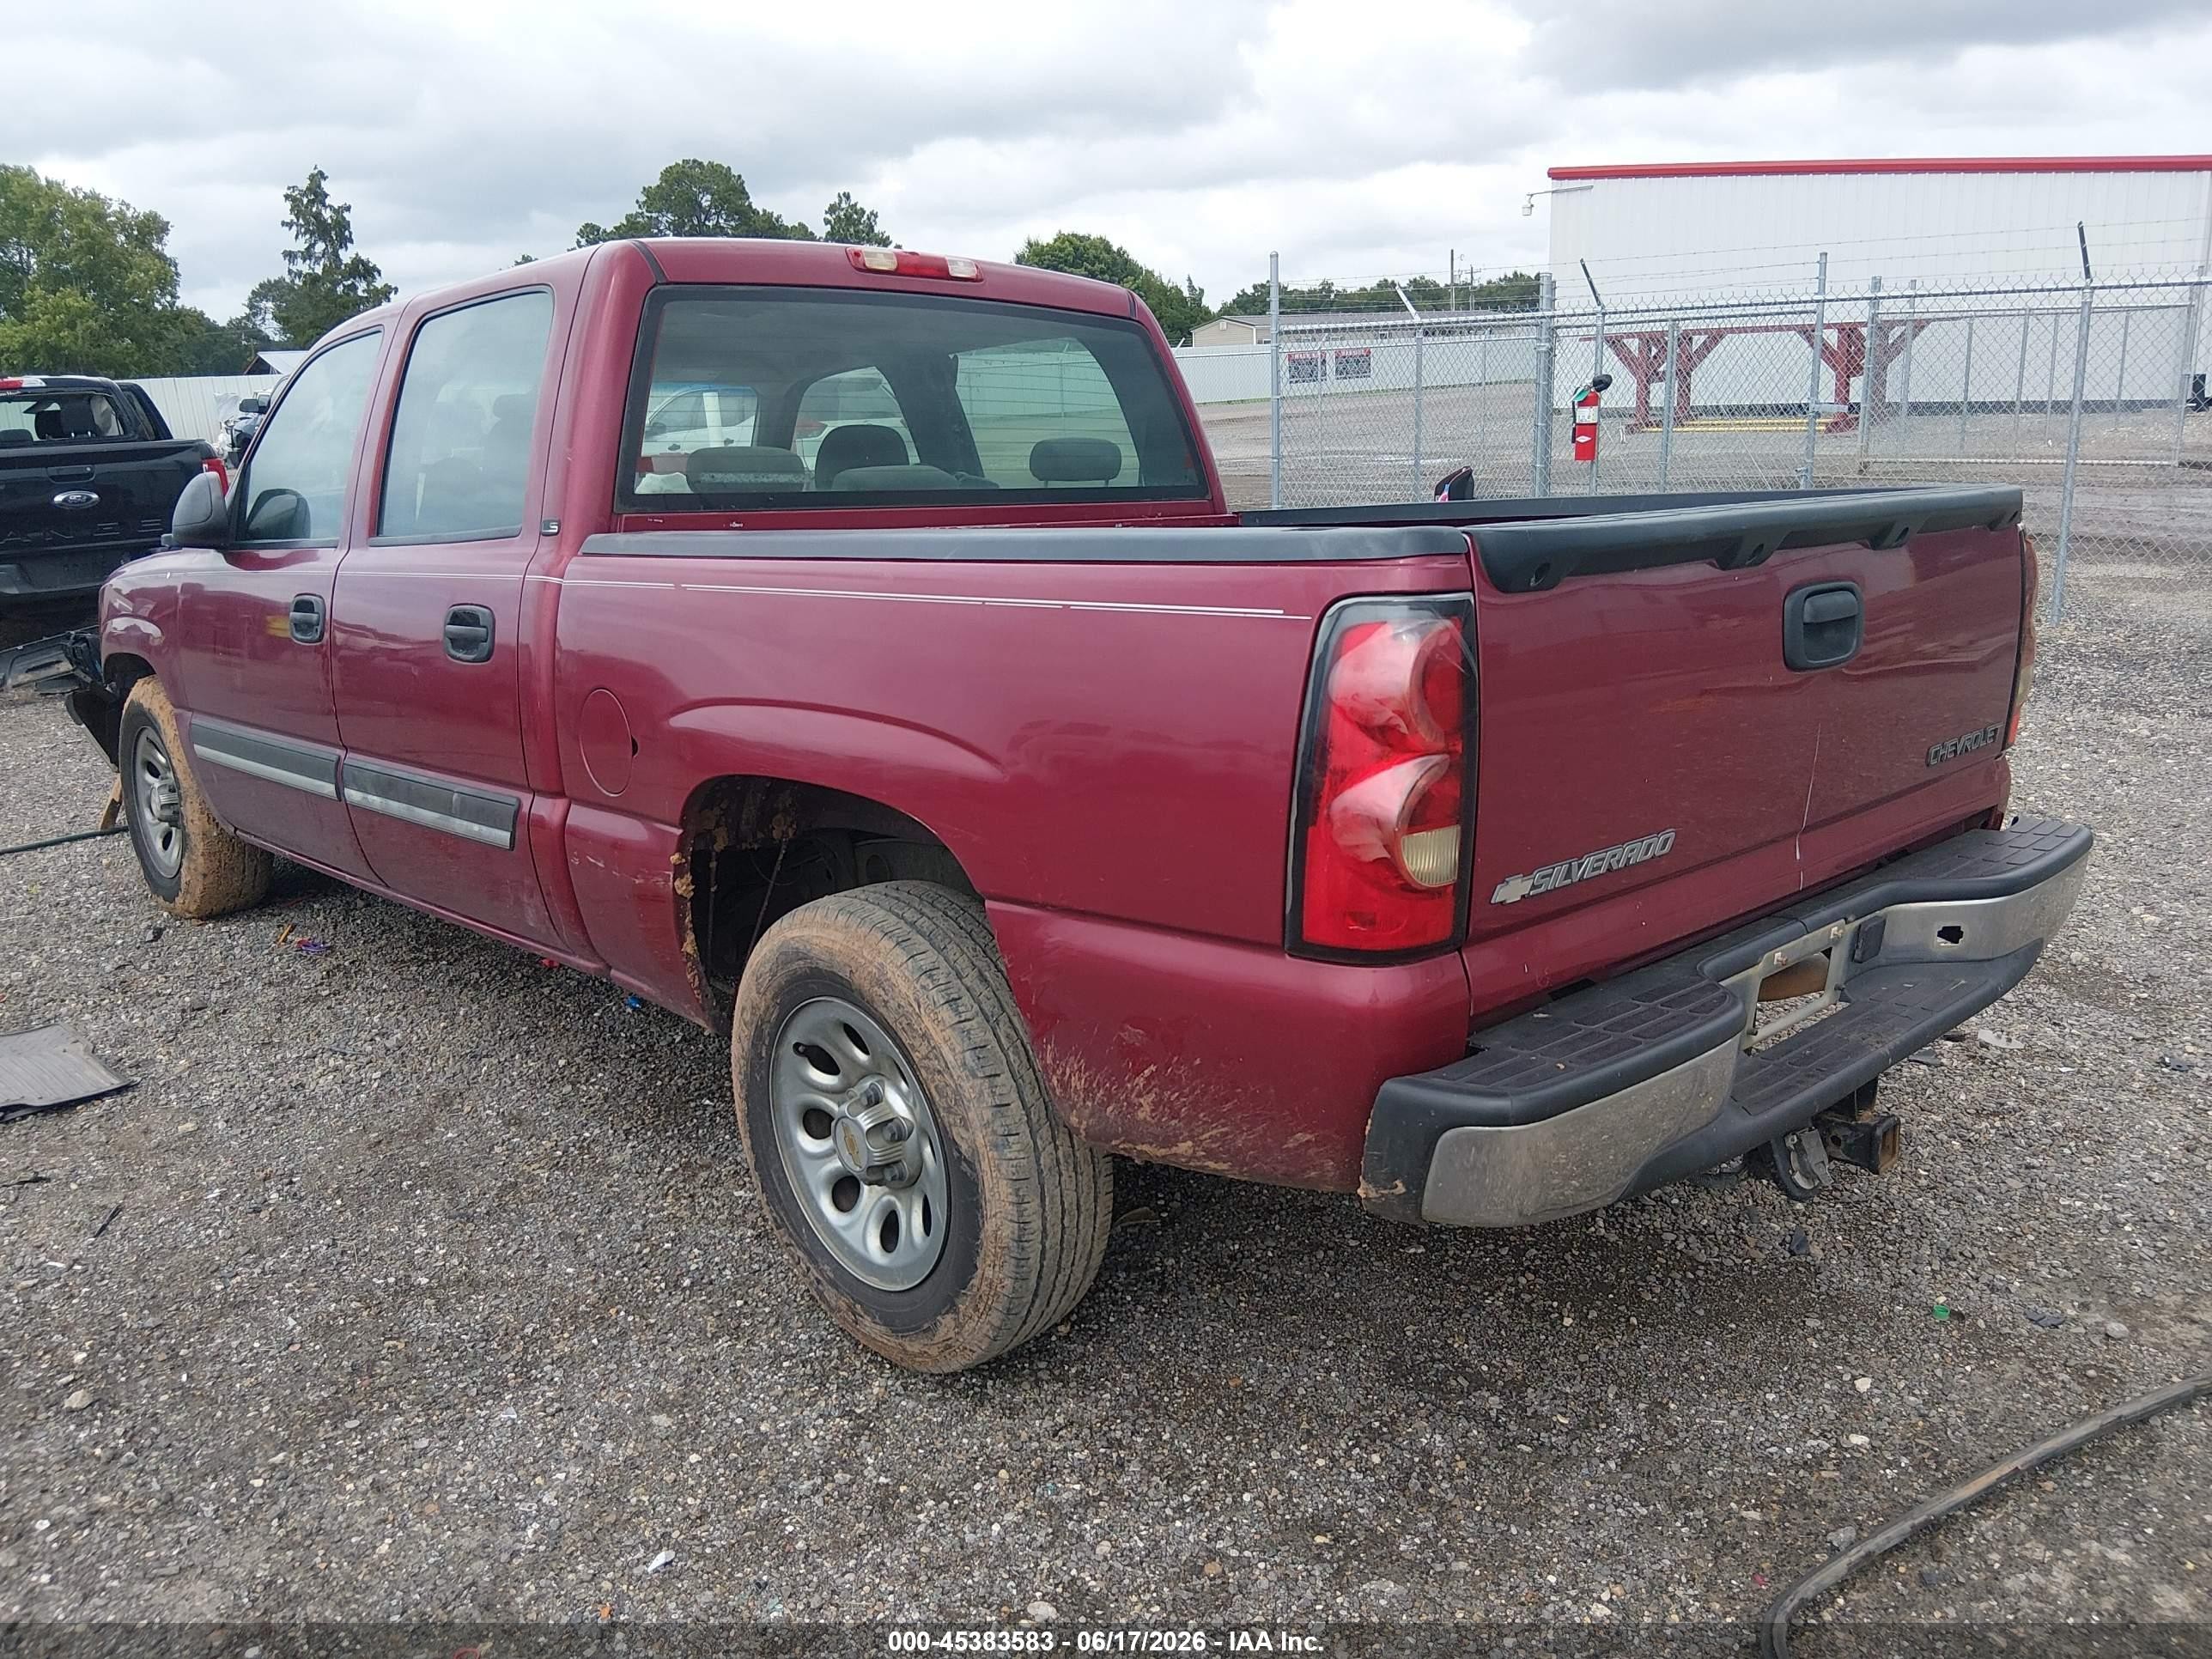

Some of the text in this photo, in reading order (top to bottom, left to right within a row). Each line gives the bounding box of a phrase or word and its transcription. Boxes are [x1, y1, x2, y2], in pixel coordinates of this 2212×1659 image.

[541, 521, 558, 533] LS
[1928, 721, 2003, 765] CHEVROLET
[1529, 828, 1676, 896] SILVERADO
